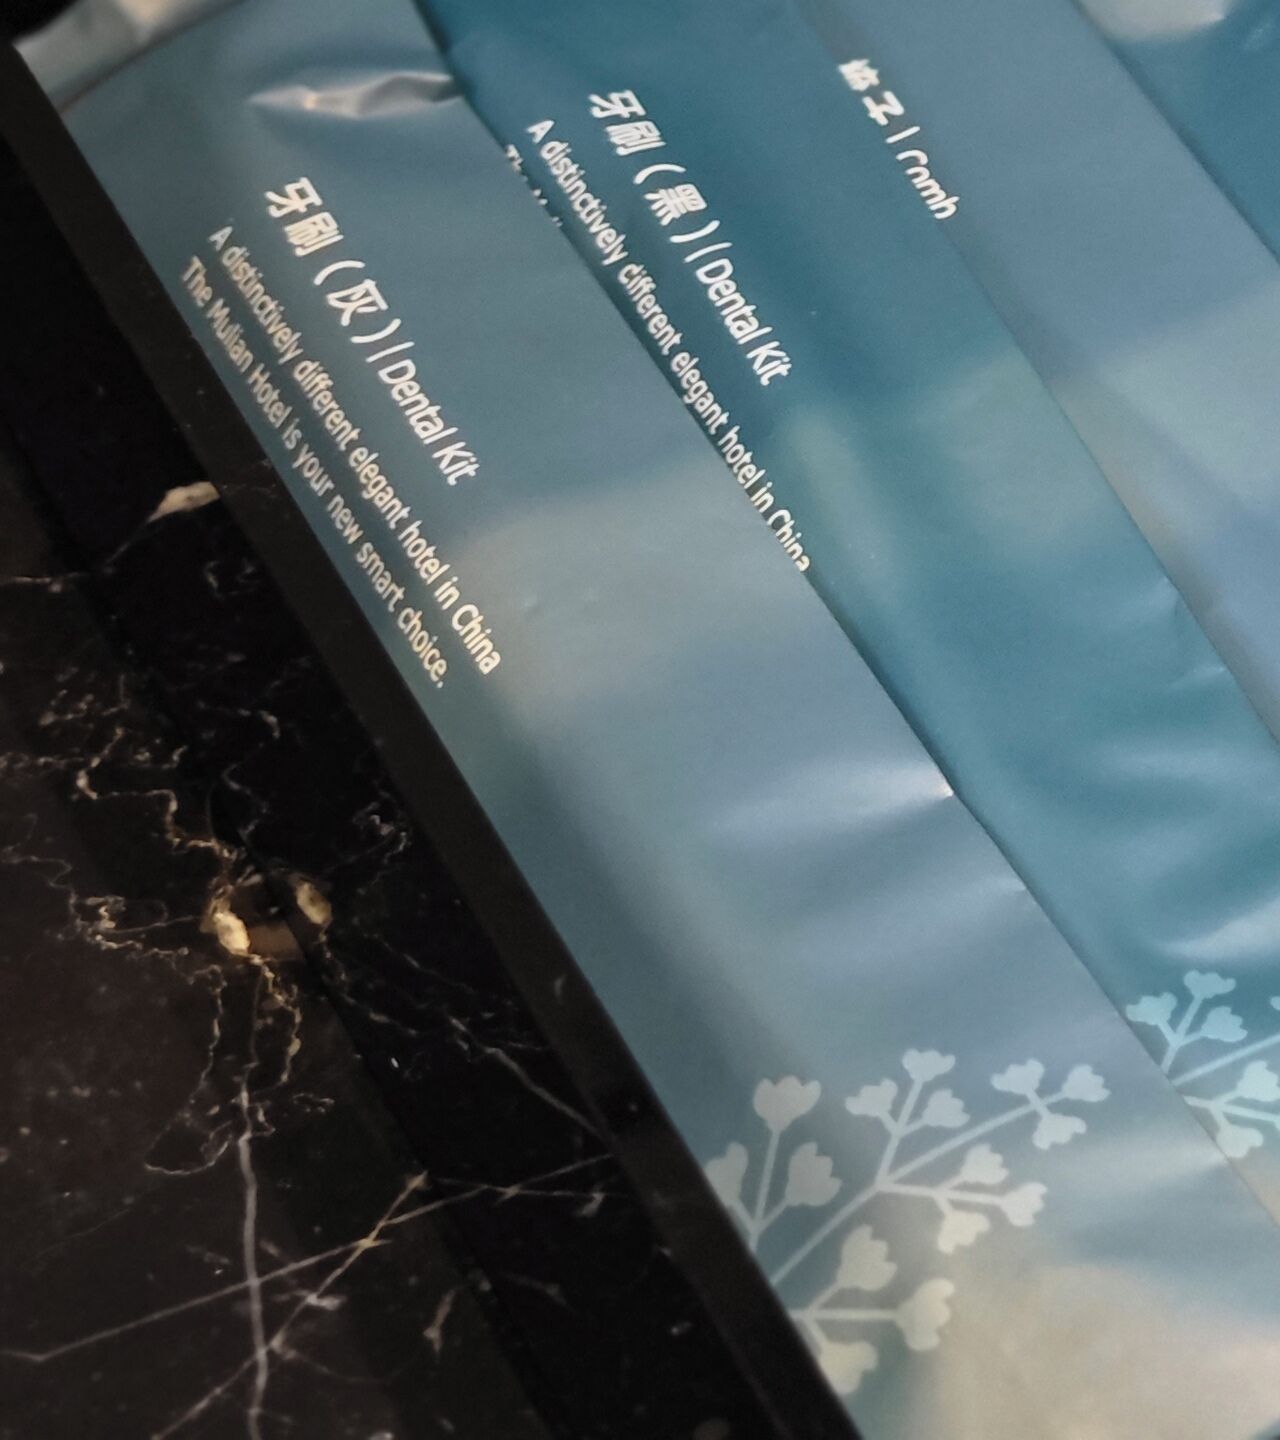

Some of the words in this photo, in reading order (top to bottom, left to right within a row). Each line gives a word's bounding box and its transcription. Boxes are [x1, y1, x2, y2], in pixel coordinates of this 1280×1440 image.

[526, 119, 555, 144] A
[539, 139, 628, 266] distinctively
[208, 225, 234, 252] A
[181, 254, 214, 308] The
[220, 245, 305, 365] distinctively
[617, 262, 684, 355] different
[205, 297, 255, 374] Mulian
[694, 257, 774, 346] Dental
[745, 340, 793, 387] Kit
[246, 362, 294, 429] Hotel
[291, 359, 362, 452] different
[376, 358, 459, 446] Dental
[430, 440, 481, 487] Kit
[669, 350, 730, 435] elegant
[281, 417, 303, 451] is
[717, 424, 767, 490] hotel
[291, 443, 336, 498] your
[347, 446, 412, 531] elegant
[745, 480, 775, 514] in
[326, 493, 365, 546] new
[397, 518, 452, 586] hotel
[766, 508, 811, 572] China
[355, 541, 406, 614] smart
[433, 575, 461, 611] in
[396, 606, 447, 690] choice.
[450, 603, 502, 677] China
